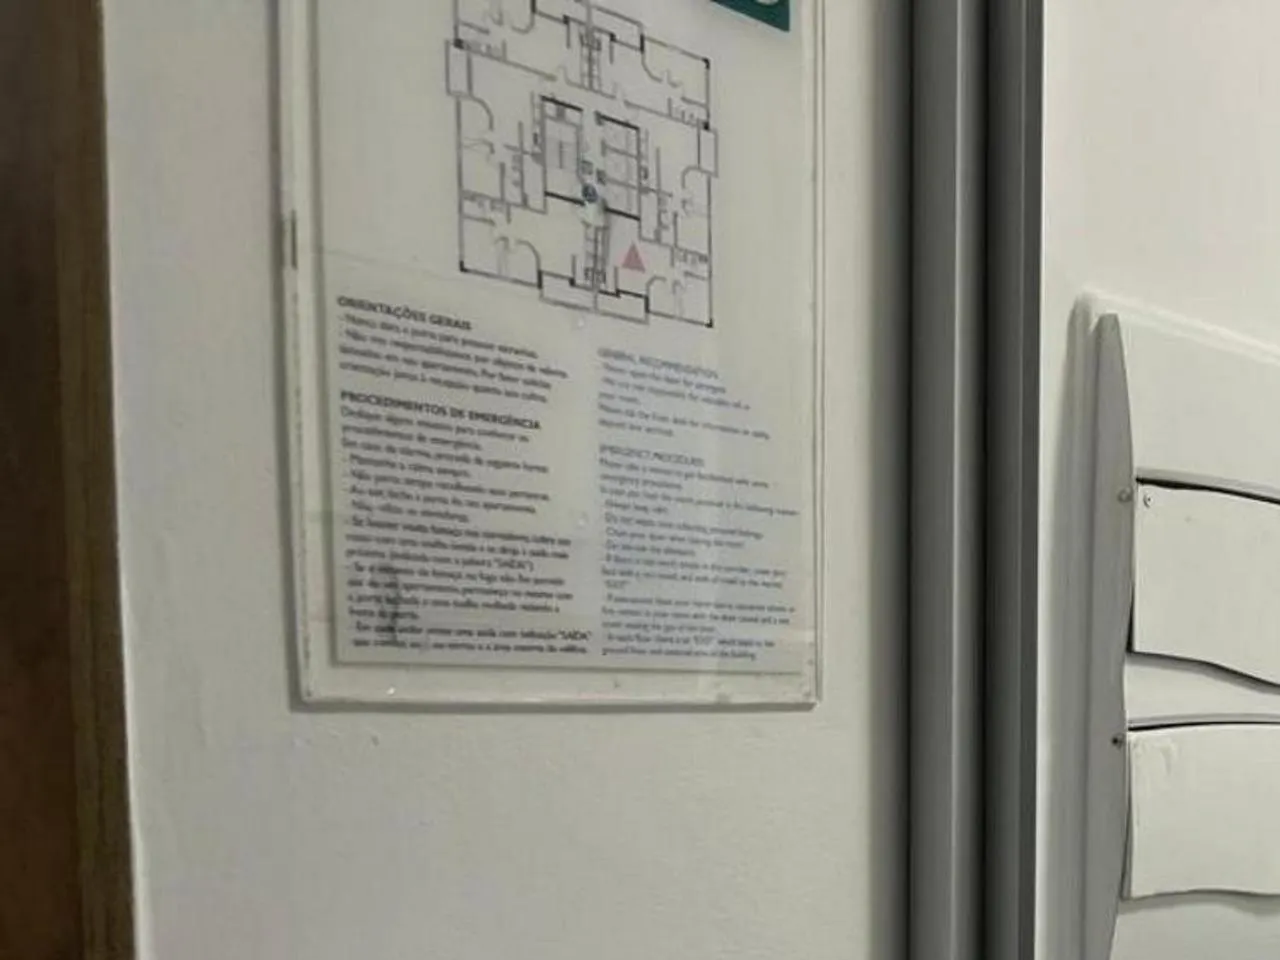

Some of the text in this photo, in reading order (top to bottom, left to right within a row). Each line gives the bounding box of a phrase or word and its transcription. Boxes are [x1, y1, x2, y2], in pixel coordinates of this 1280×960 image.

[429, 313, 472, 331] GERAIS
[340, 391, 447, 417] PROCEDIMENTOS
[450, 407, 465, 419] DE
